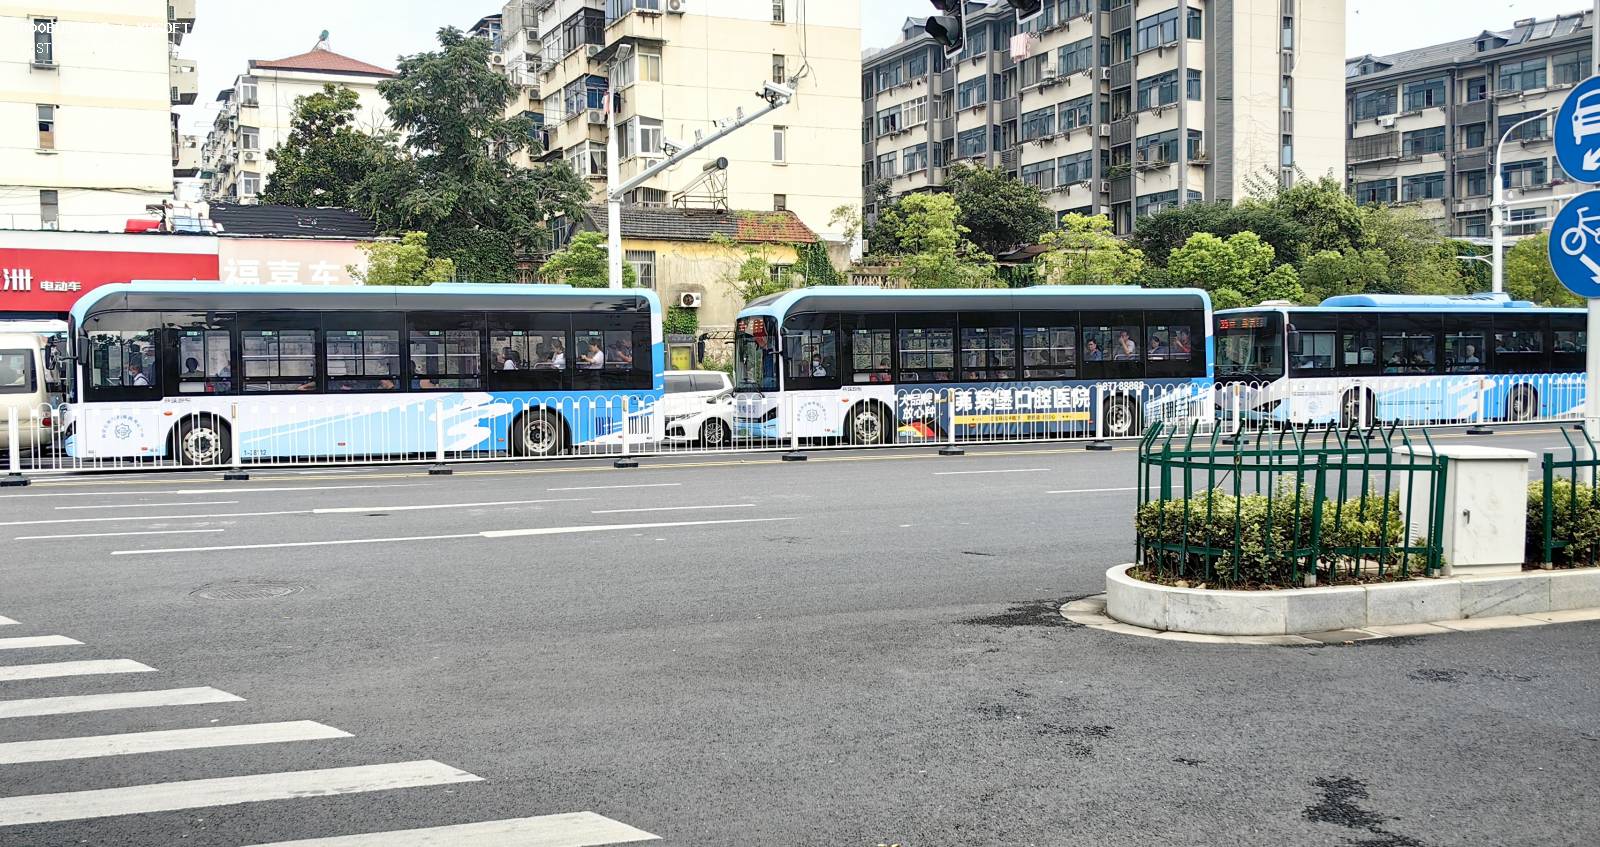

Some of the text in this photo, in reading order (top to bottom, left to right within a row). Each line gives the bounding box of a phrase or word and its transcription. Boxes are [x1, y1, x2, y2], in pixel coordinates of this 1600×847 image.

[0, 268, 33, 292] 洲
[40, 280, 82, 293] 电动车
